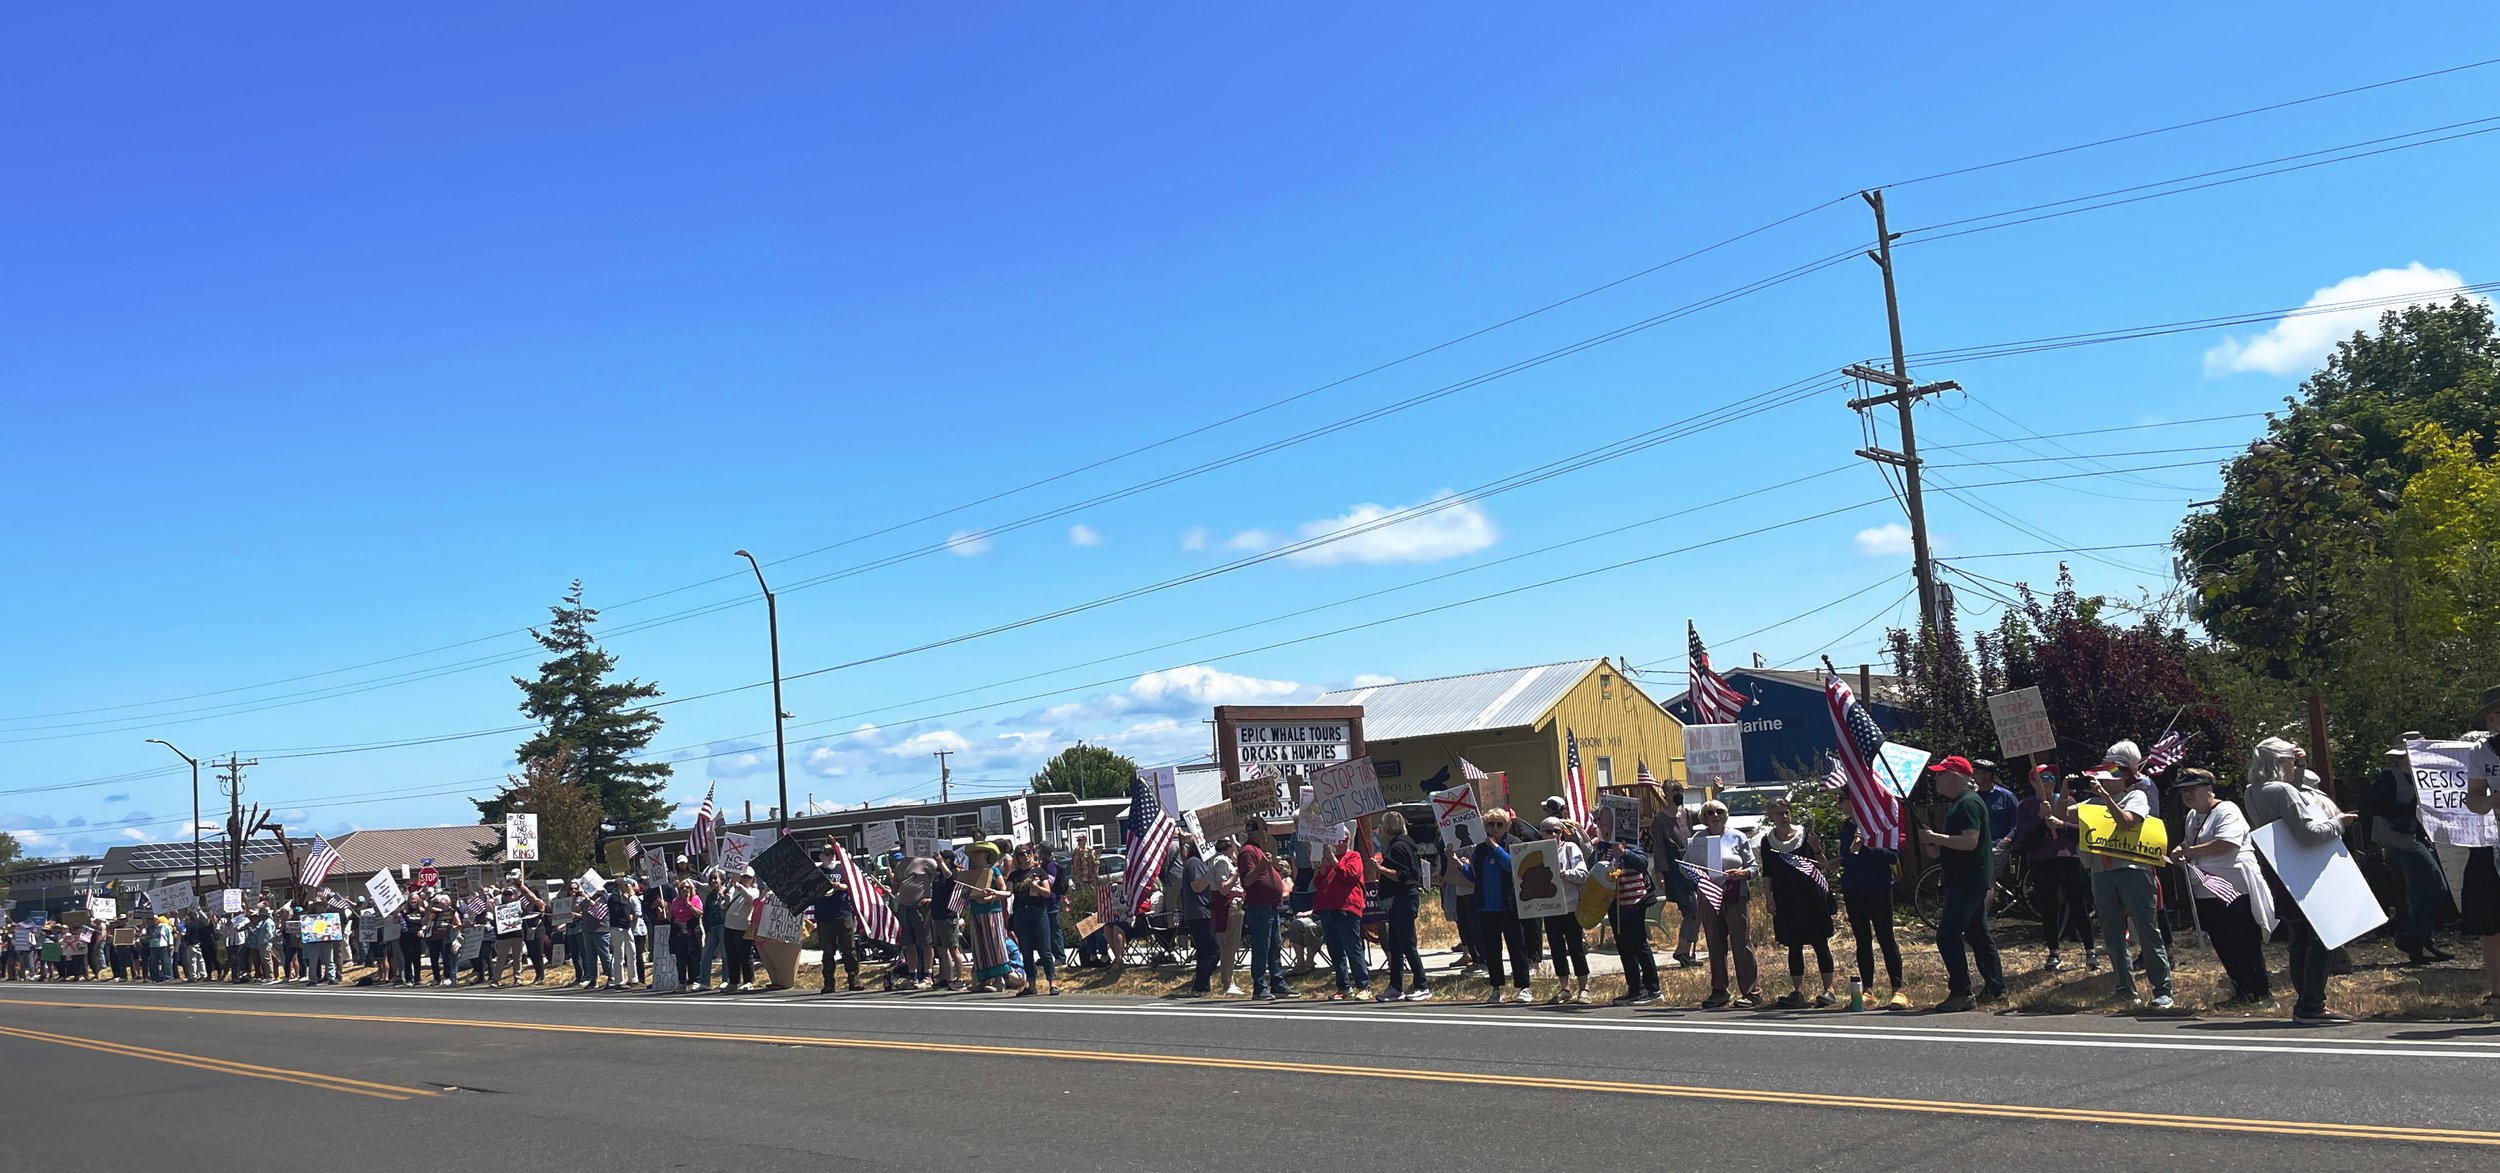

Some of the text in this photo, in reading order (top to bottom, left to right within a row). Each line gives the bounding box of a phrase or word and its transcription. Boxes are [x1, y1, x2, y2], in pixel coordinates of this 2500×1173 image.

[1740, 718, 1783, 733] arine
[1241, 726, 1341, 742] EPIC WHALE TOURS
[1242, 746, 1278, 761] ORCAS
[1292, 745, 1336, 760] HUMPIES
[1242, 777, 1270, 791] CONS
[1320, 762, 1377, 795] STOP THIS
[2416, 770, 2466, 789] RESIS
[1249, 796, 1276, 812] KINGS
[1322, 794, 1348, 825] SHIT
[1352, 785, 1386, 815] SHOW
[1440, 812, 1476, 829] NO KINGS
[917, 830, 936, 838] KINGS
[2085, 828, 2162, 856] Constitution
[513, 848, 535, 859] KINGS
[726, 854, 742, 863] NO
[420, 873, 437, 882] STOP
[651, 866, 661, 876] NO
[74, 887, 103, 896] Kitap
[770, 919, 800, 935] TRUMP
